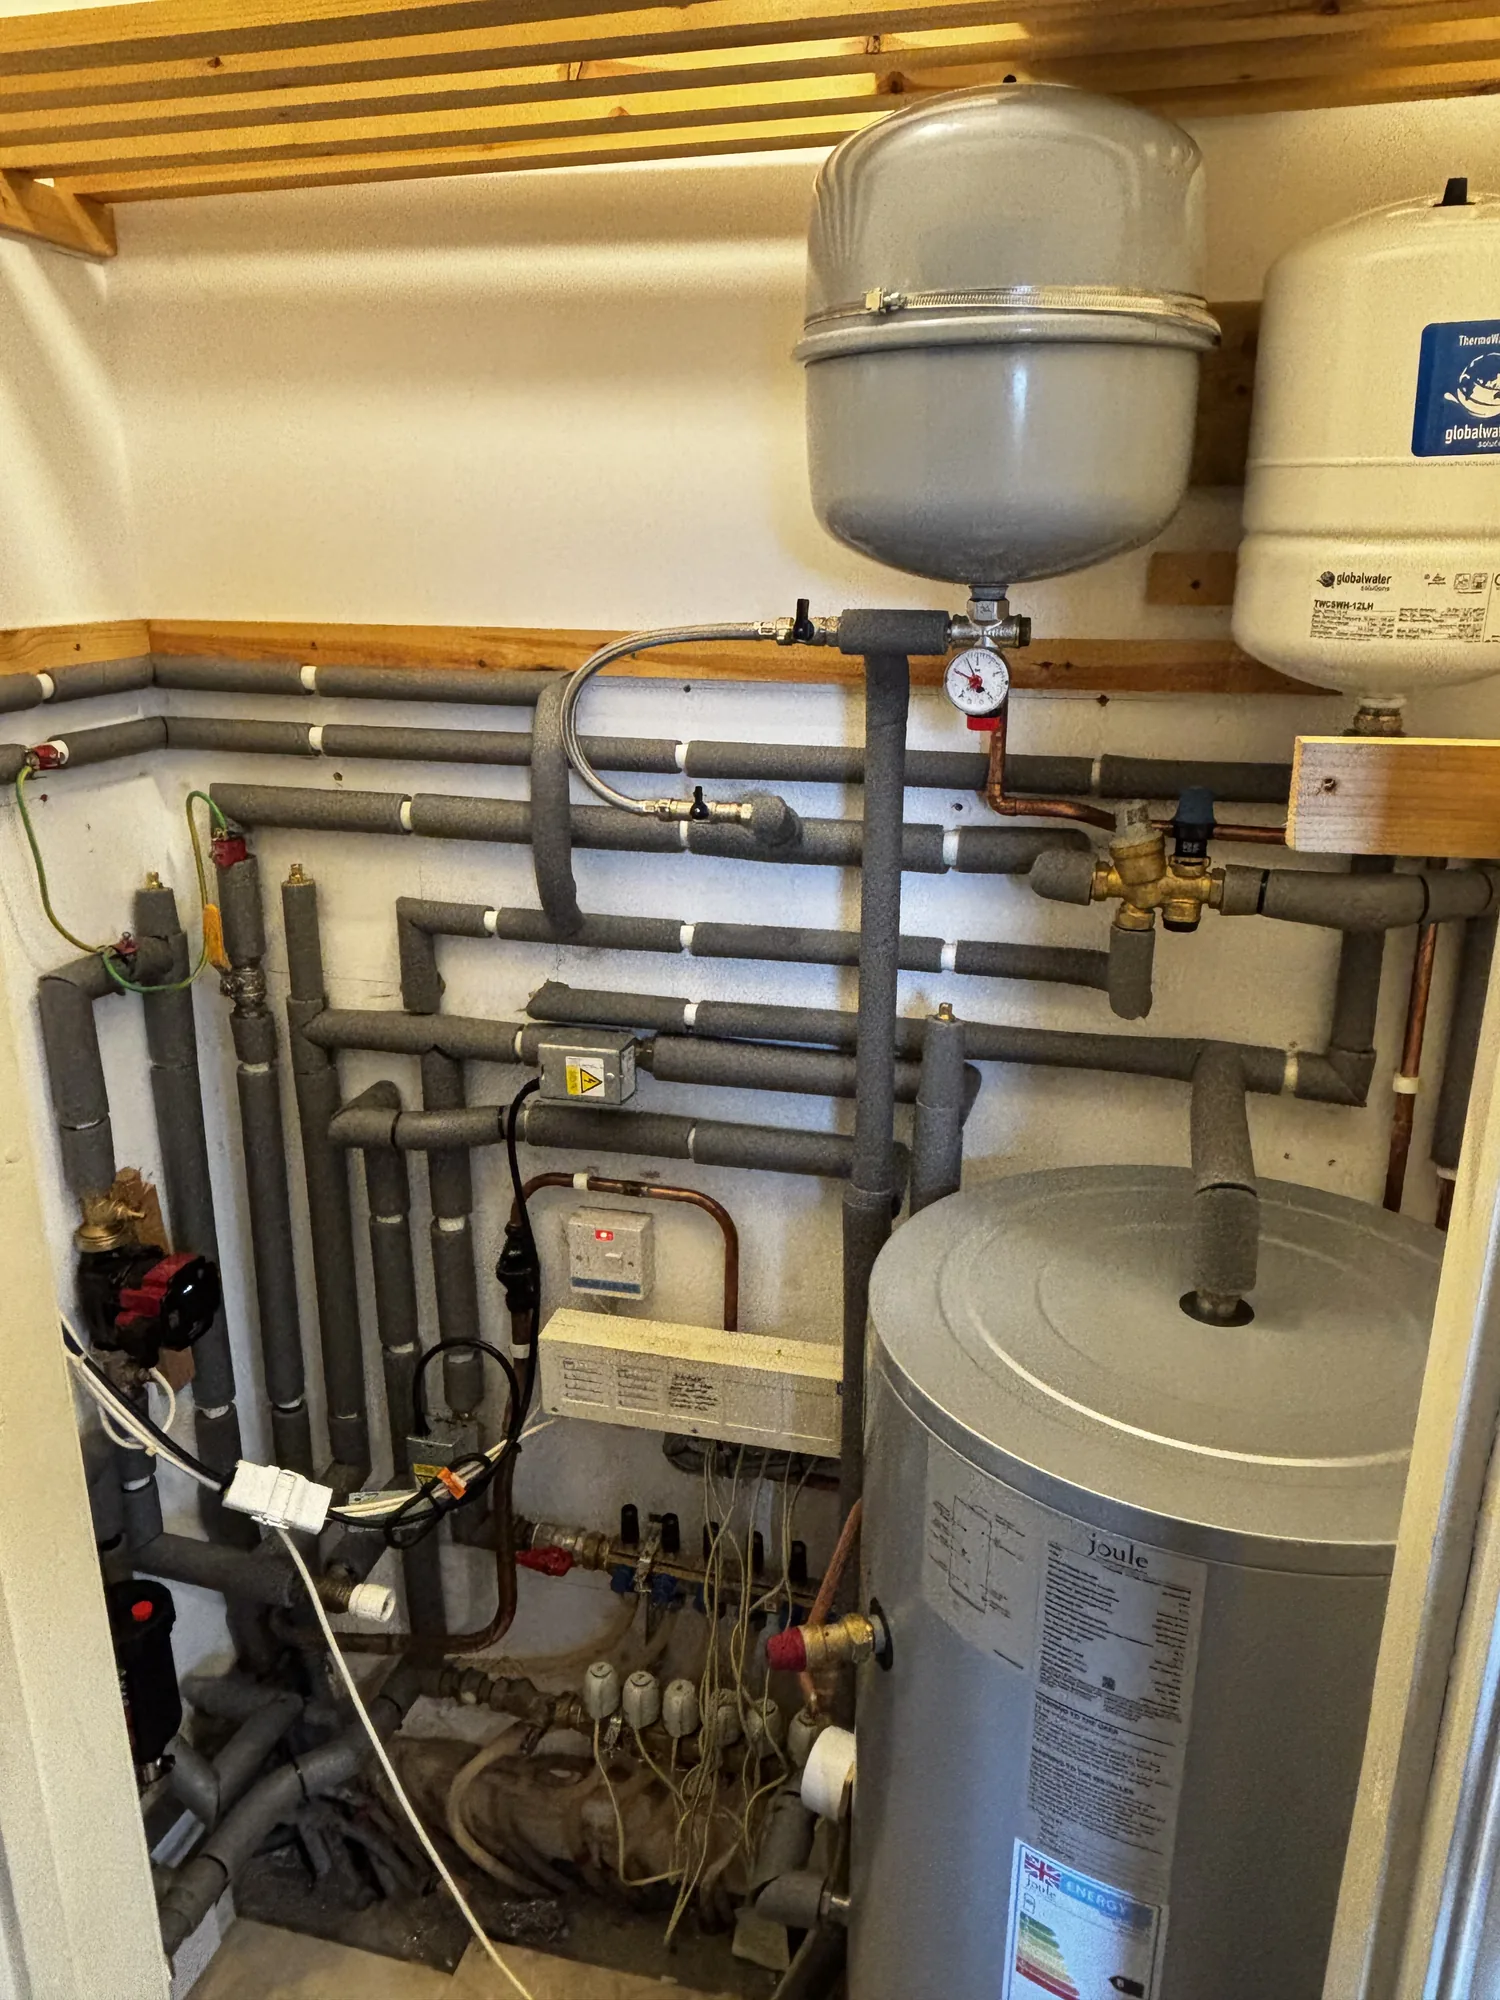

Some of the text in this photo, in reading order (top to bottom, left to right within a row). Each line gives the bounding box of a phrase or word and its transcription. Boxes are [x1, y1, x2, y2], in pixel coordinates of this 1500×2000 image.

[1444, 423, 1500, 445] globalwa
[1336, 572, 1392, 586] globalwater
[1087, 1532, 1149, 1569] joule
[1065, 1880, 1128, 1914] ENERGY
